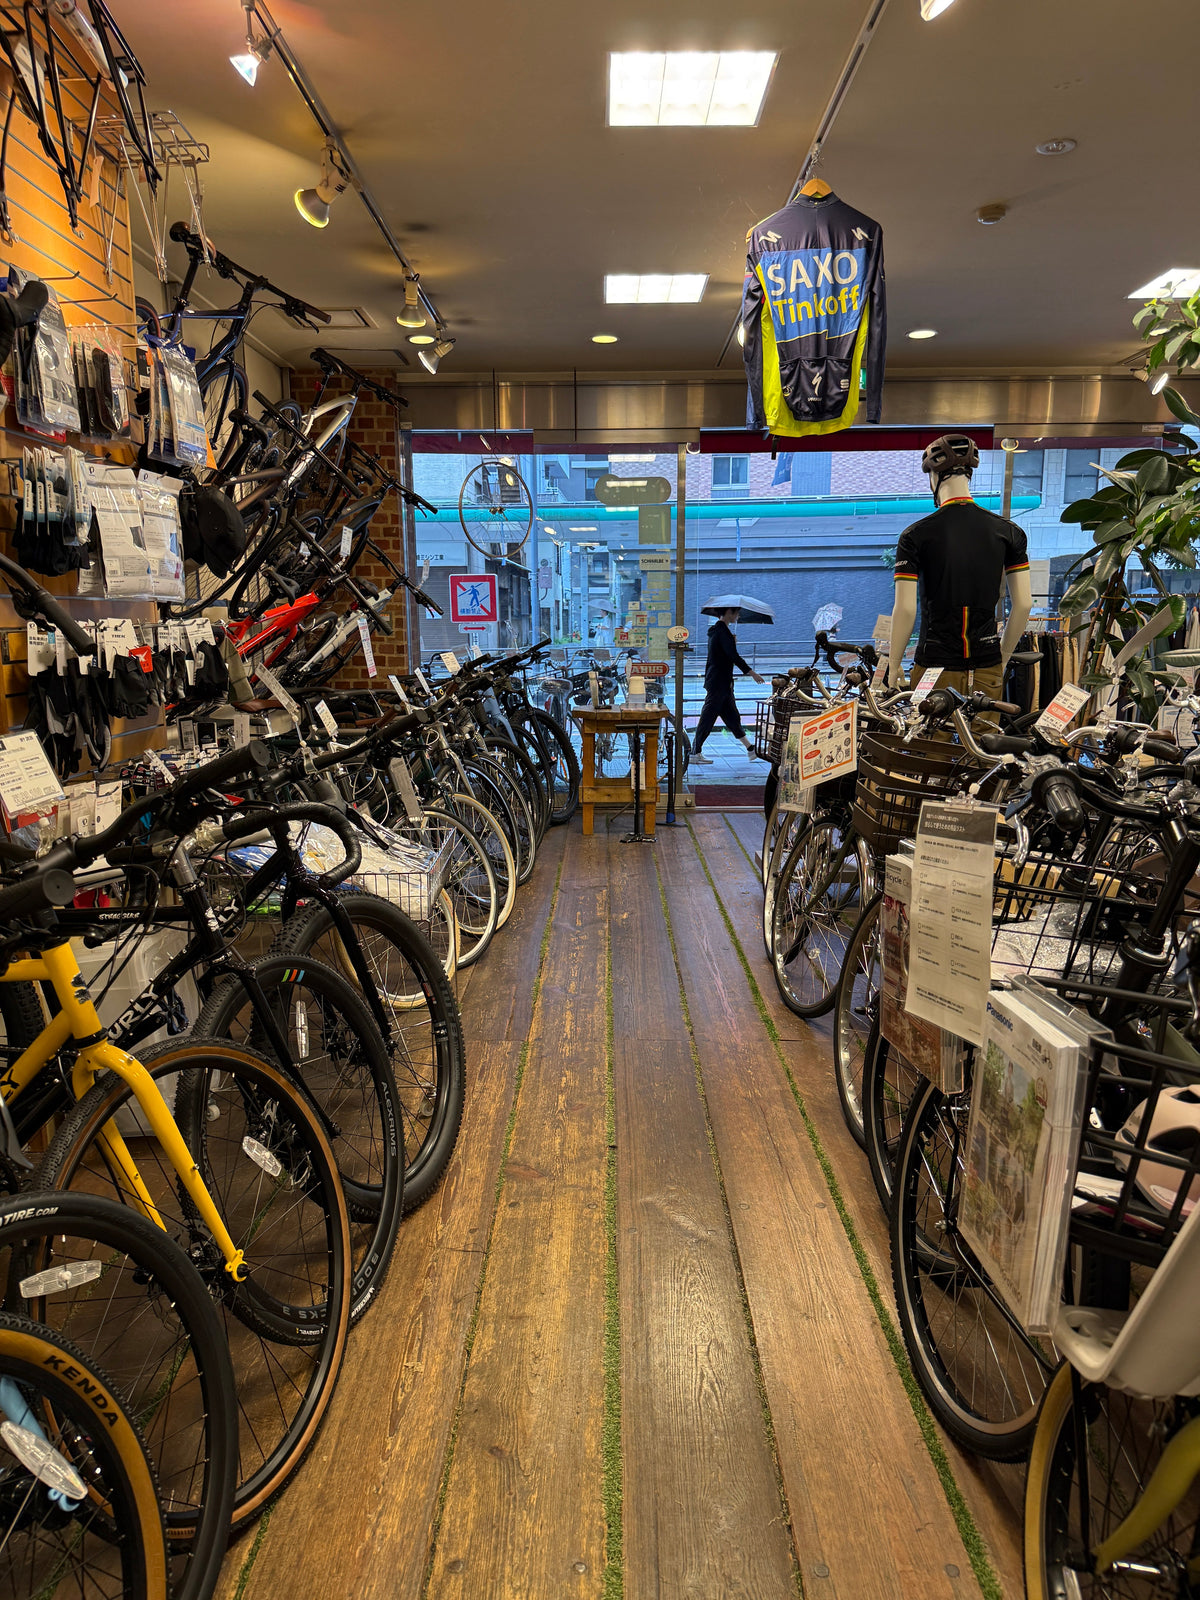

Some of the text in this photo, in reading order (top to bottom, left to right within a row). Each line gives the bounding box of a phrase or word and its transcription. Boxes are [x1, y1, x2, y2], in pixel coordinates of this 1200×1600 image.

[766, 251, 859, 297] SAXO
[772, 284, 860, 326] Tinkoff
[631, 665, 664, 674] ABUS
[107, 984, 159, 1042] URLY
[986, 1001, 1014, 1032] Panasonic
[381, 1081, 397, 1157] ALEXRIMS
[43, 1355, 119, 1427] KENDA
